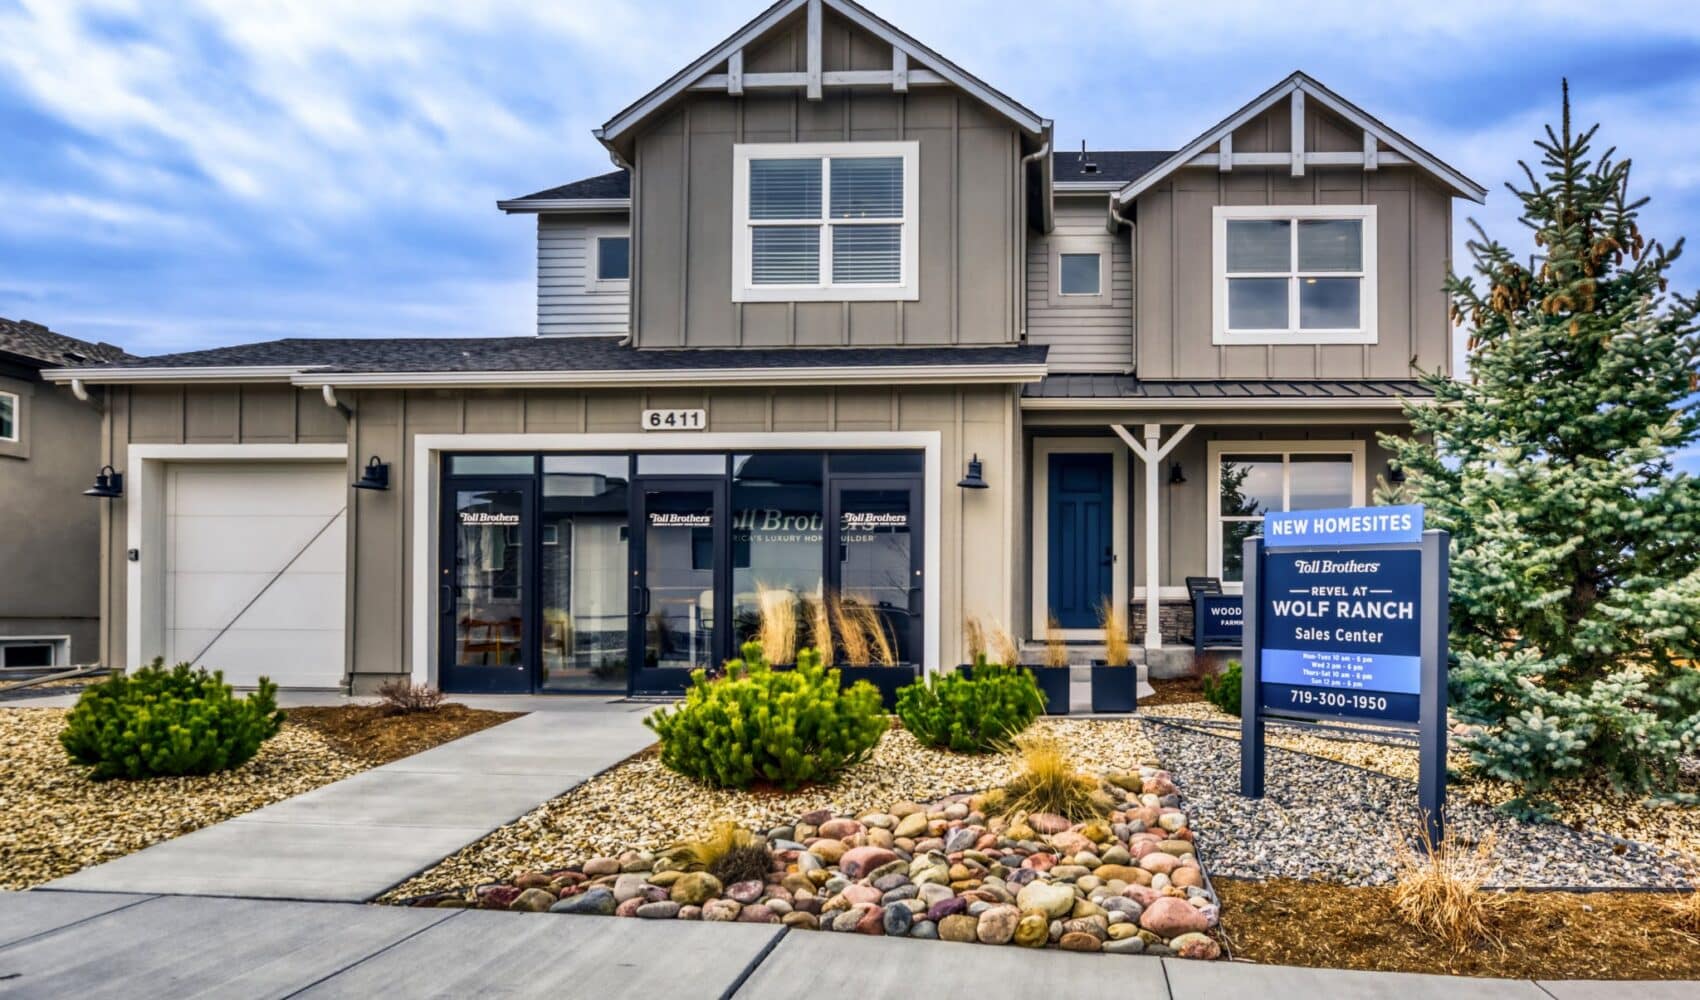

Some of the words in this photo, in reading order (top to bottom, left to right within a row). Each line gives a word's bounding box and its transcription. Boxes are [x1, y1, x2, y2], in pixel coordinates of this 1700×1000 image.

[650, 412, 698, 427] 6411
[460, 512, 479, 521] Toll
[480, 512, 519, 521] Brothers
[649, 513, 669, 522] Toll
[670, 513, 710, 522] Brothers
[844, 512, 864, 521] Toll
[865, 512, 906, 521] Brothers
[1272, 519, 1308, 535] NEW
[1314, 514, 1412, 534] HOMESITES
[1295, 560, 1320, 573] Toll
[1322, 560, 1380, 573] Brothers
[1311, 587, 1348, 596] REVEL
[1352, 586, 1368, 596] AT
[1272, 600, 1330, 617] WOLF
[1337, 601, 1414, 619] RANCH
[1295, 627, 1330, 641] Sales
[1335, 629, 1383, 643] Center
[1290, 690, 1387, 710] 719-300-1950
